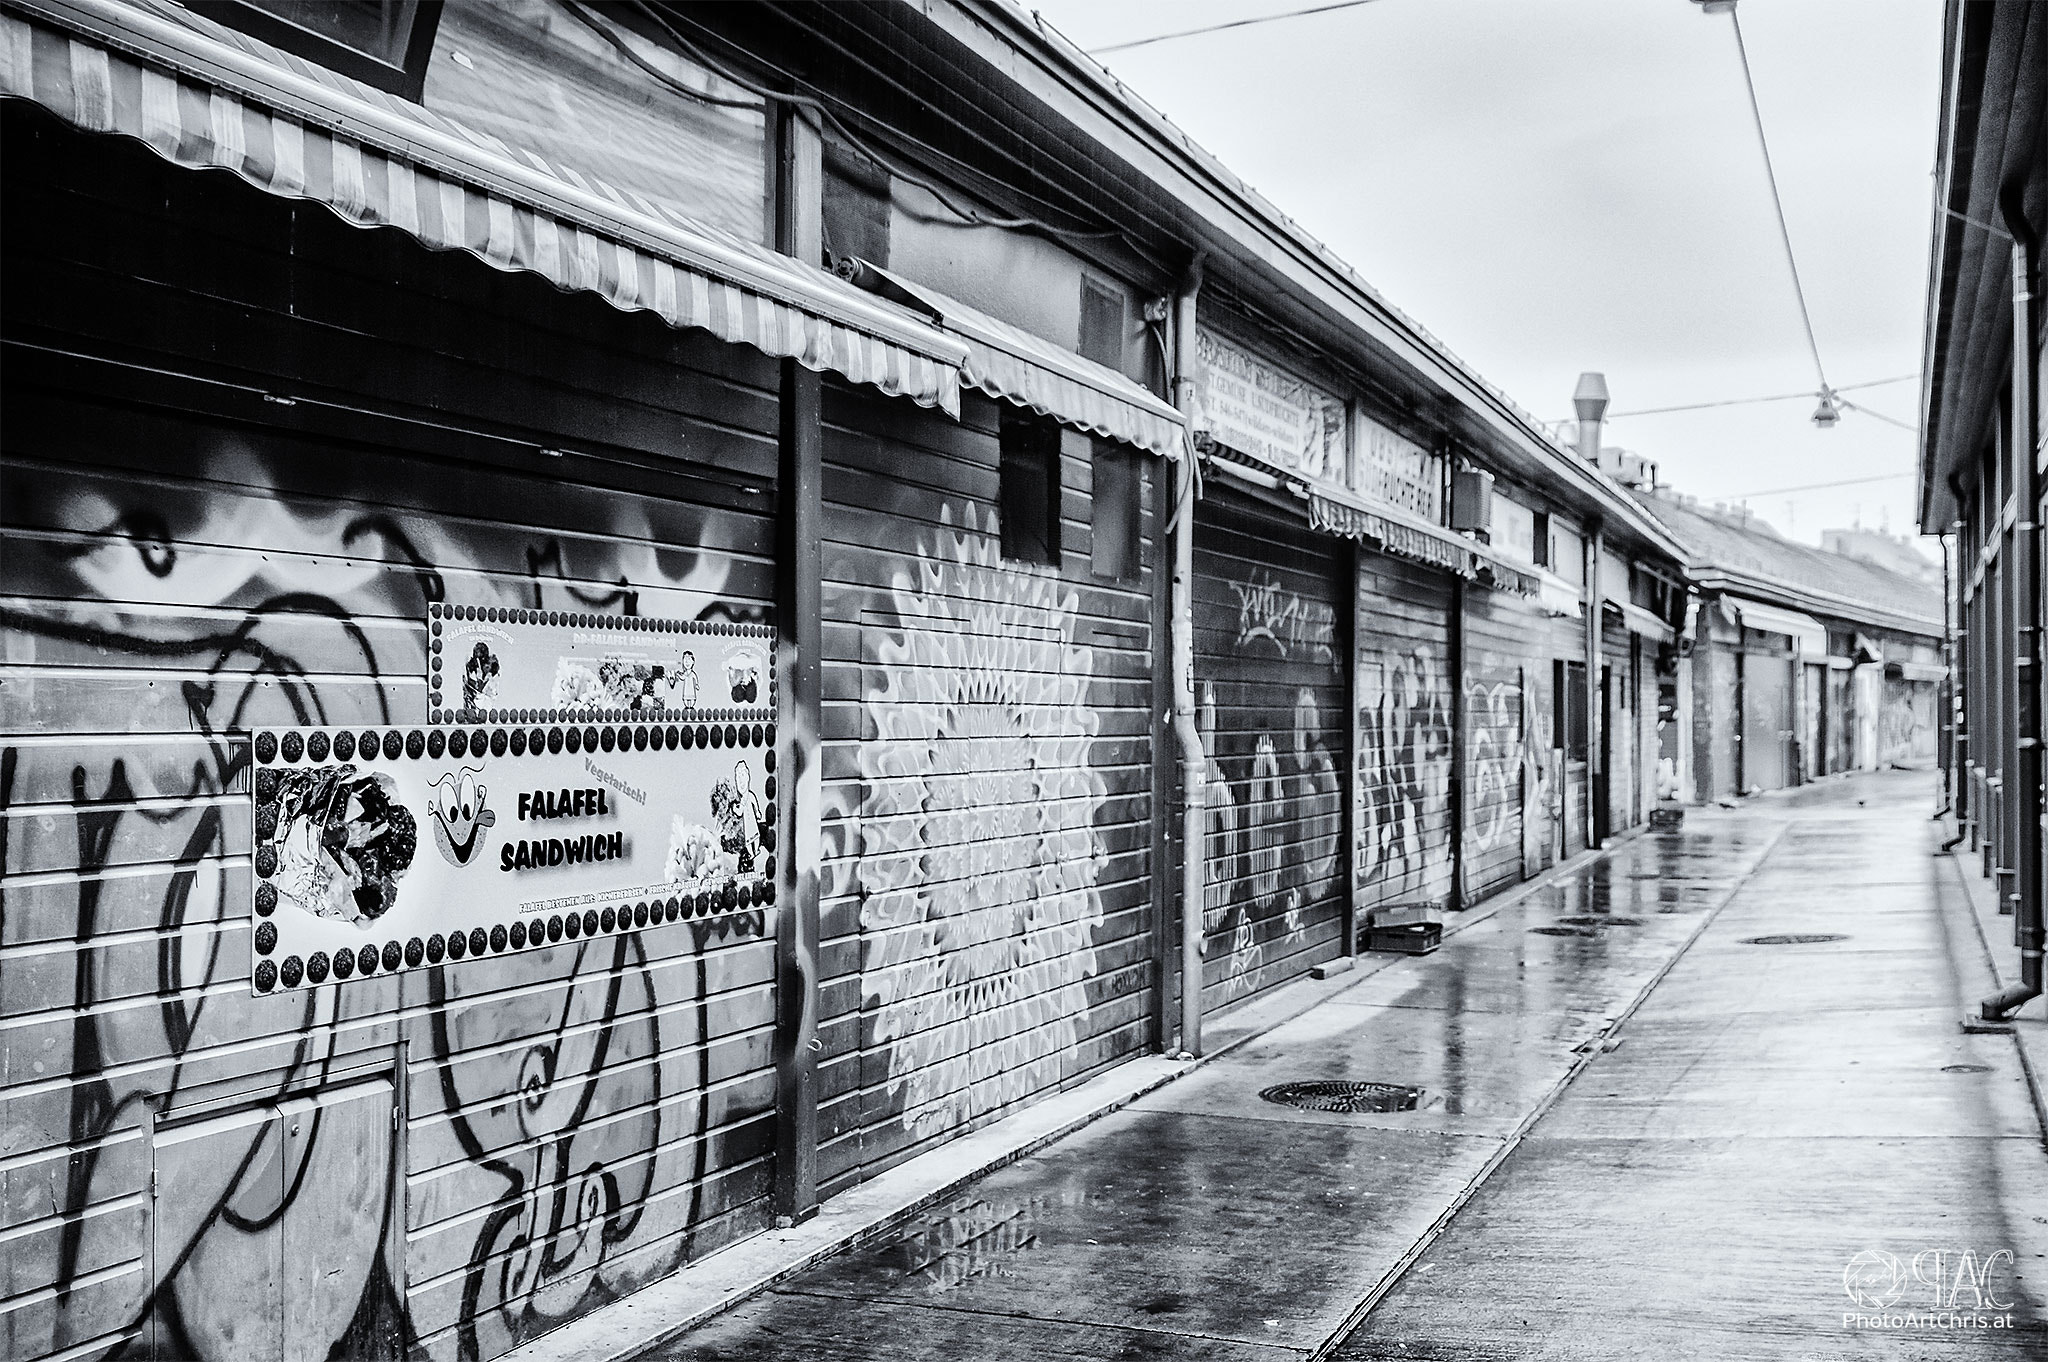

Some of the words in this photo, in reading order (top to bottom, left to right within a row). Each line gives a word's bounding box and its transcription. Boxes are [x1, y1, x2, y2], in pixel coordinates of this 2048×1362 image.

[446, 624, 476, 642] FALAFEL
[630, 635, 677, 648] SANDWICH
[585, 757, 647, 806] Vegetarisch!
[517, 787, 610, 821] FALAFEL
[499, 830, 623, 873] SANDWICH
[519, 900, 546, 914] FALAFEL
[546, 896, 580, 910] BESTEHEN
